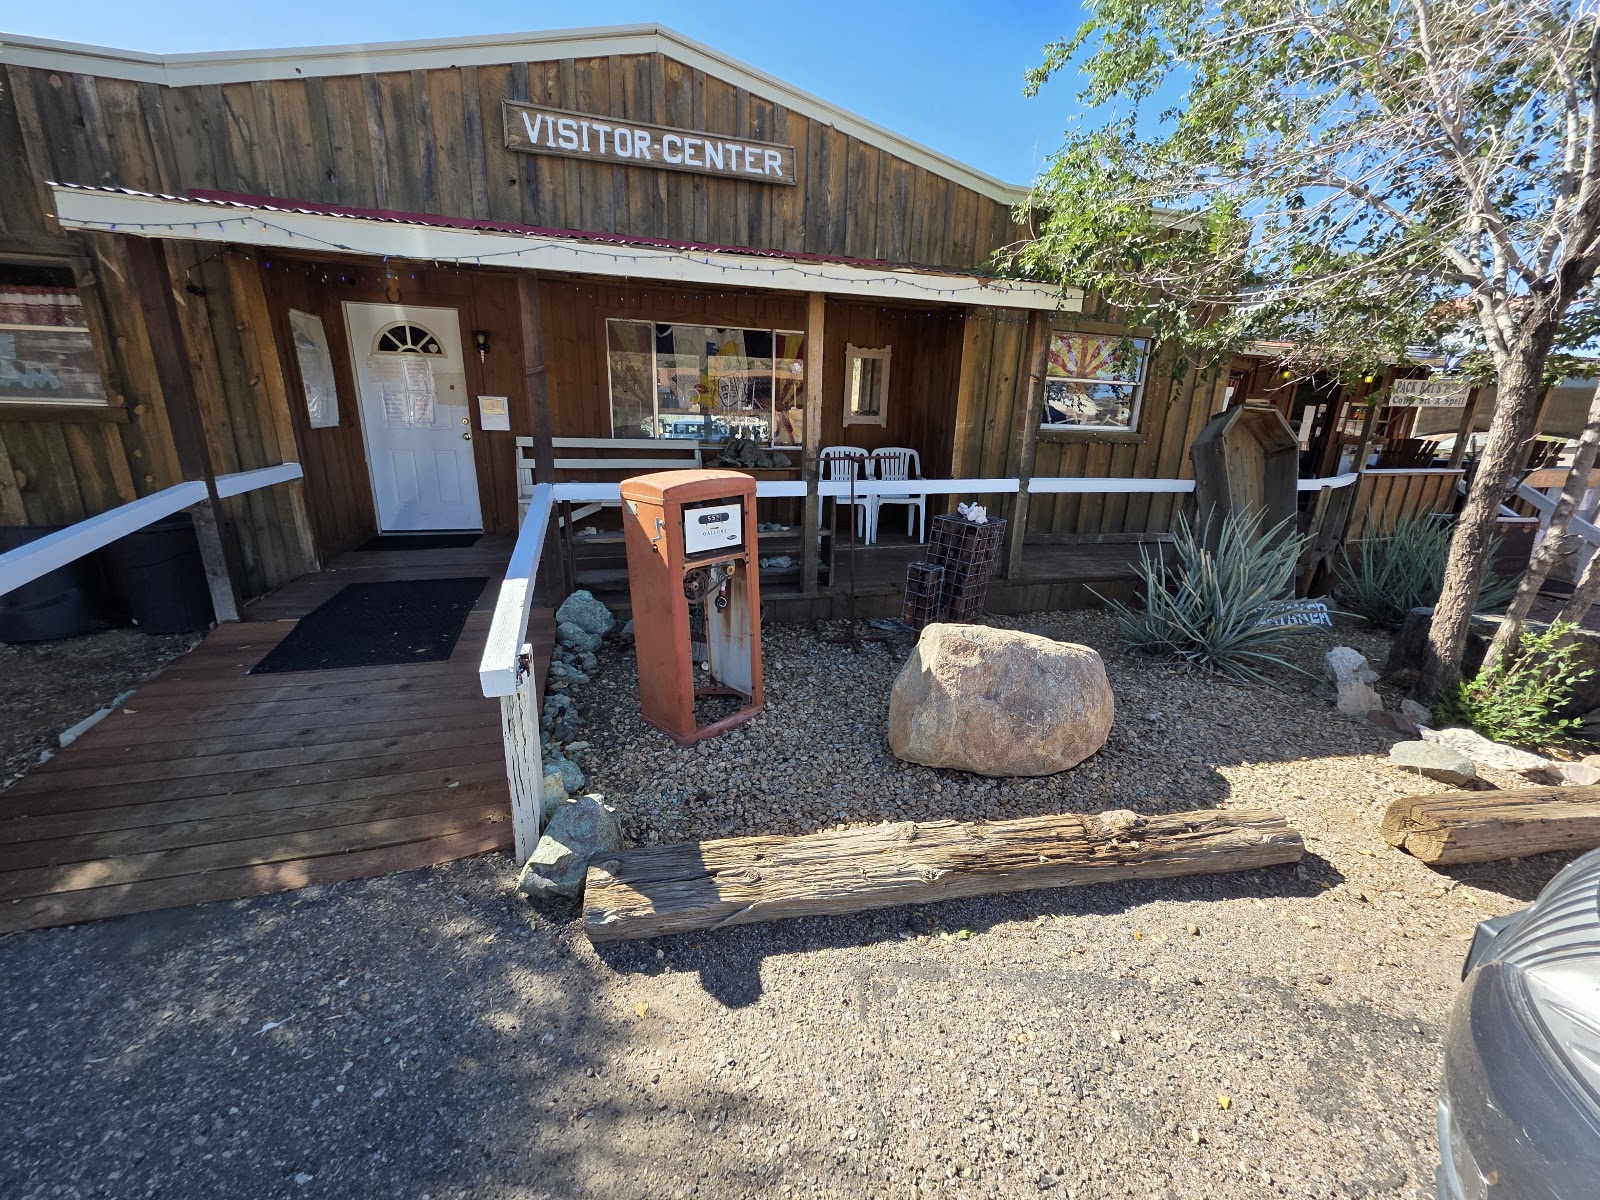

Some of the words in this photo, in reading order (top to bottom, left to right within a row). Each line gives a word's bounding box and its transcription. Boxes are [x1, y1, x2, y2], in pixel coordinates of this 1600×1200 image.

[522, 111, 783, 176] VISITOR-CENTER
[1396, 381, 1418, 393] PACK
[1443, 396, 1466, 407] Spell
